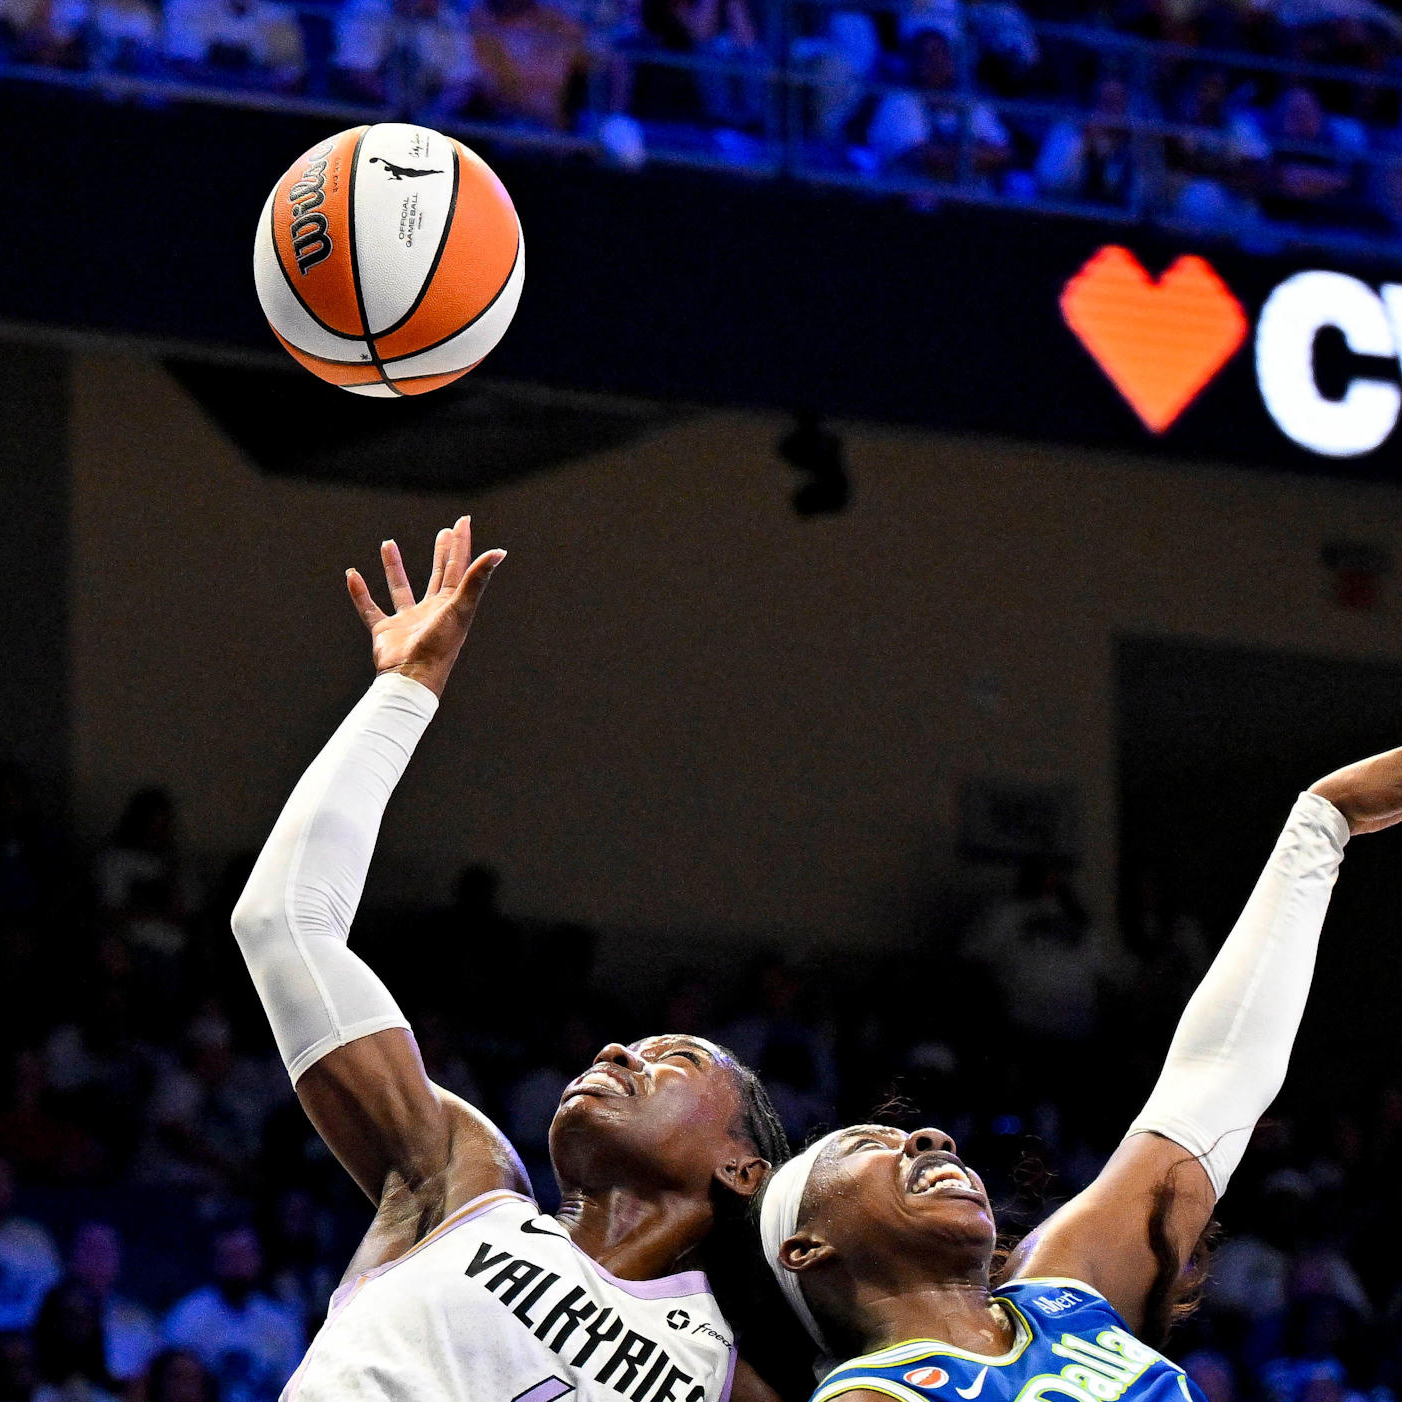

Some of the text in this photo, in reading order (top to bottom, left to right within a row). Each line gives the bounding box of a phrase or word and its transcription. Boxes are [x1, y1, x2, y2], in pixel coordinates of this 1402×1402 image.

[287, 141, 334, 276] Wilso
[399, 197, 409, 239] OFFICIAL
[406, 192, 418, 247] GAME BALL
[1032, 1290, 1083, 1314] Albert
